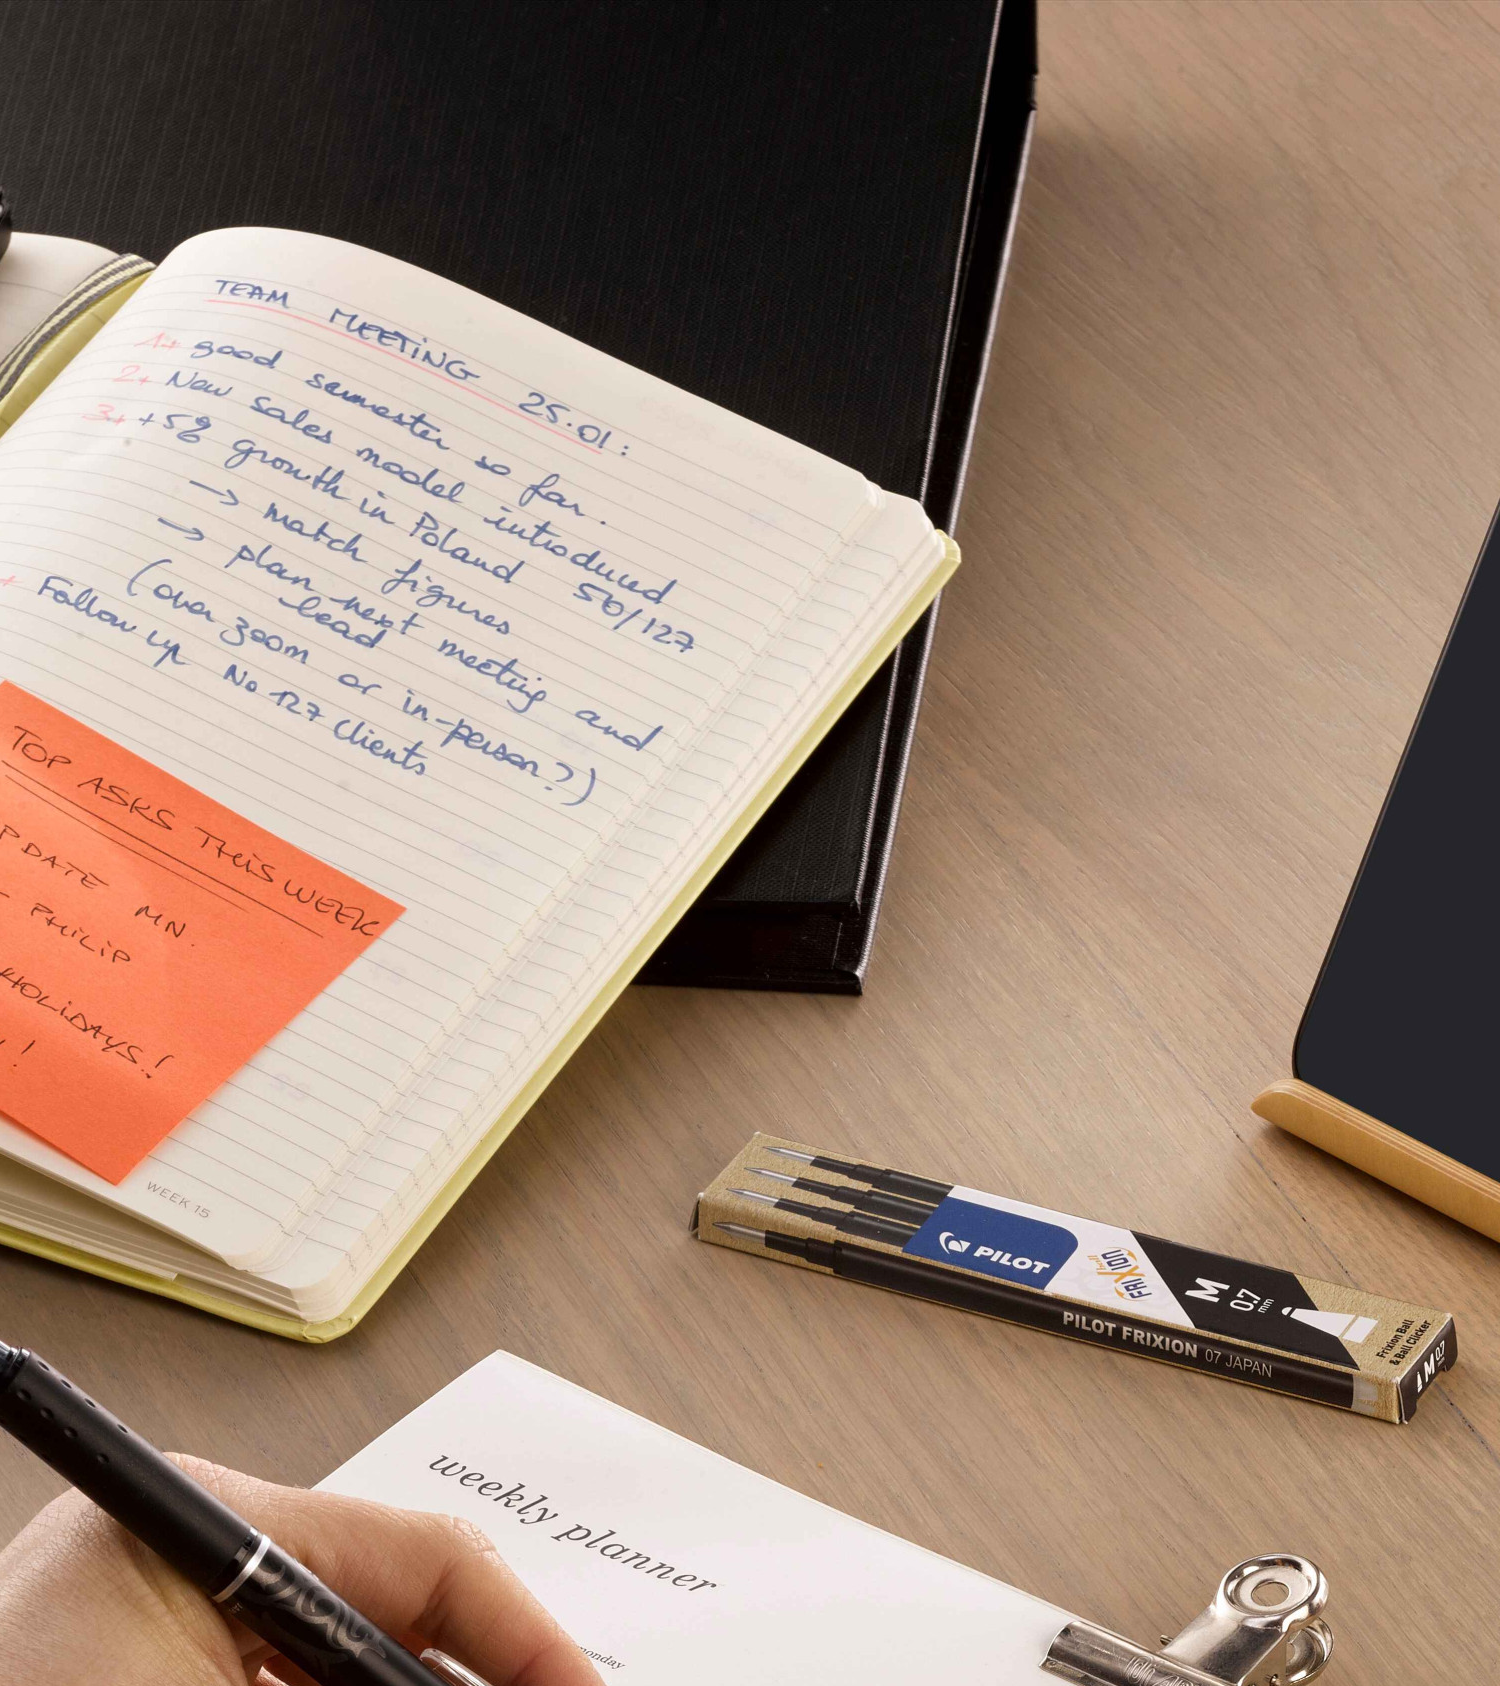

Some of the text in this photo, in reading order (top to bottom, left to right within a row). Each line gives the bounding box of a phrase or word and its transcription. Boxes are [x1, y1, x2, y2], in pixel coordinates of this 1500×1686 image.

[216, 278, 291, 310] TEAM
[190, 340, 284, 369] good
[474, 455, 512, 476] so
[224, 438, 695, 653] growth in Poland 50/127
[356, 446, 466, 504] model
[483, 505, 677, 605] introduced
[264, 503, 511, 636] match figures
[37, 575, 137, 634] Follow
[147, 629, 192, 669] up
[223, 544, 664, 752] plan next meeting and
[338, 673, 383, 695] or
[8, 725, 383, 938] TOP ASKS WEEK
[146, 1179, 212, 1219] WEEK 15
[973, 1245, 1051, 1275] PILOT
[1185, 1276, 1231, 1304] M
[1229, 1287, 1262, 1313] 0.7
[1062, 1310, 1273, 1378] PILOT FRIXION 07 JAPAN
[1375, 1317, 1416, 1360] Frixion Ball
[1405, 1319, 1433, 1348] Clicker
[1423, 1352, 1436, 1383] M
[426, 1452, 717, 1596] weekly planner
